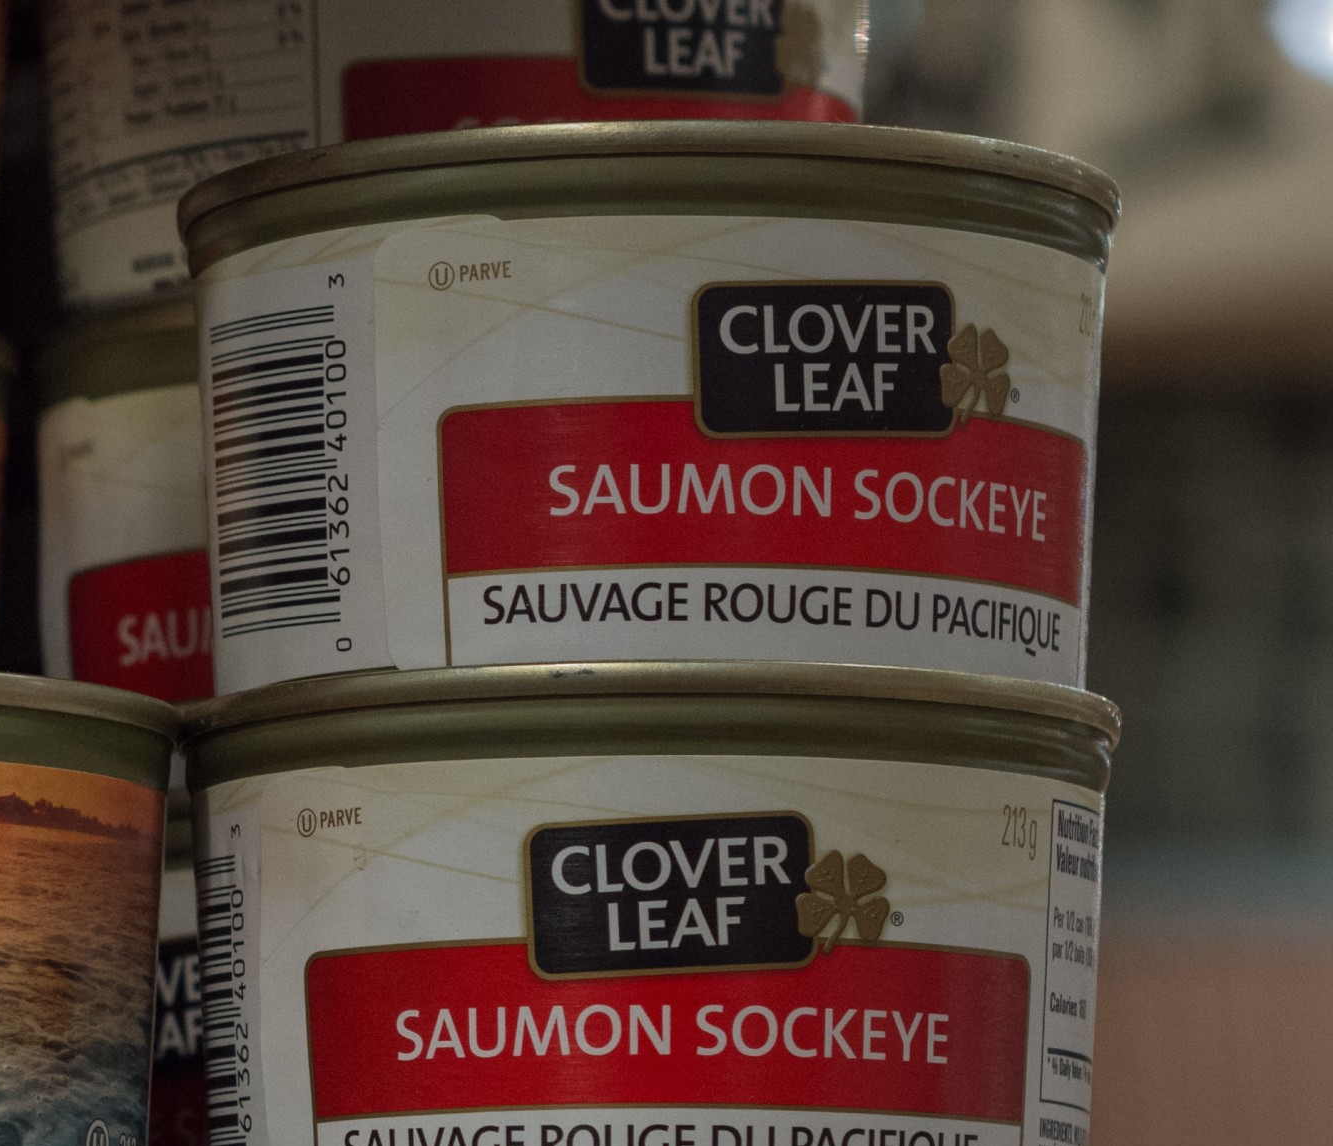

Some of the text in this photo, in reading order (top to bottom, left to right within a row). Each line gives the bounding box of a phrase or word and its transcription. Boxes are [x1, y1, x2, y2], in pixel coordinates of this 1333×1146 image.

[643, 28, 747, 78] LEAF
[459, 261, 511, 281] PARVE
[719, 304, 937, 355] CLOVER
[775, 363, 899, 412] LEAF
[549, 463, 1046, 543] SAUMON SOCKEYE
[482, 582, 1060, 656] SAUVAGE ROUGE DU PACIFIQUE
[551, 836, 791, 895] CLOVER
[607, 896, 745, 952] LEAF
[396, 1003, 950, 1065] SAUMON SOCKEYE
